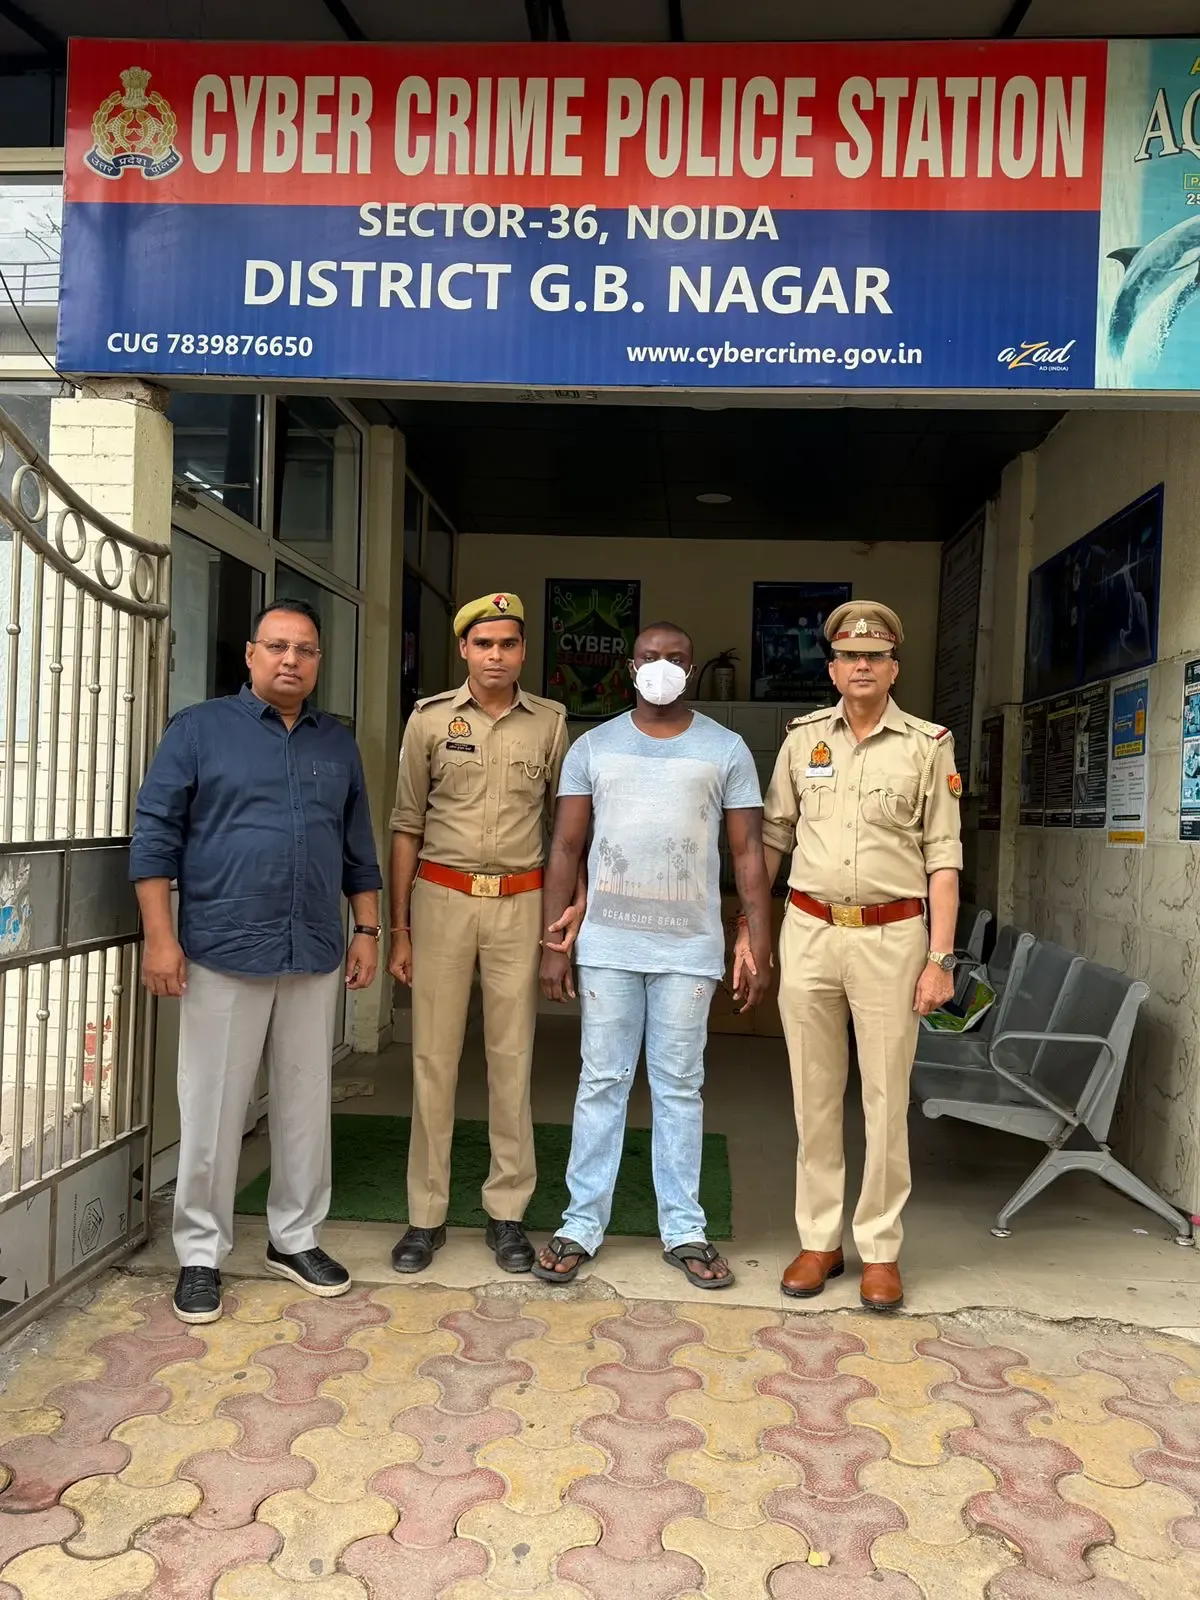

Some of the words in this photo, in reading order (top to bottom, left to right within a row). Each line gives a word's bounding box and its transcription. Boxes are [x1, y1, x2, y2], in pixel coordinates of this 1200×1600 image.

[191, 73, 373, 174] CYBER
[394, 75, 585, 176] CRIME
[604, 76, 816, 178] POLICE
[835, 75, 1087, 179] STATION
[359, 202, 609, 245] SECTOR-36,
[627, 204, 780, 241] NOIDA
[244, 259, 512, 310] DISTRICT
[530, 263, 645, 313] G.B.
[668, 265, 894, 315] NAGAR
[107, 333, 159, 353] CUG
[167, 334, 313, 357] 7839876650
[626, 341, 923, 370] www.cybercrime.gov.in
[559, 632, 625, 655] CYBER
[602, 908, 653, 924] OCEANSIDE
[657, 916, 689, 926] BEACH
